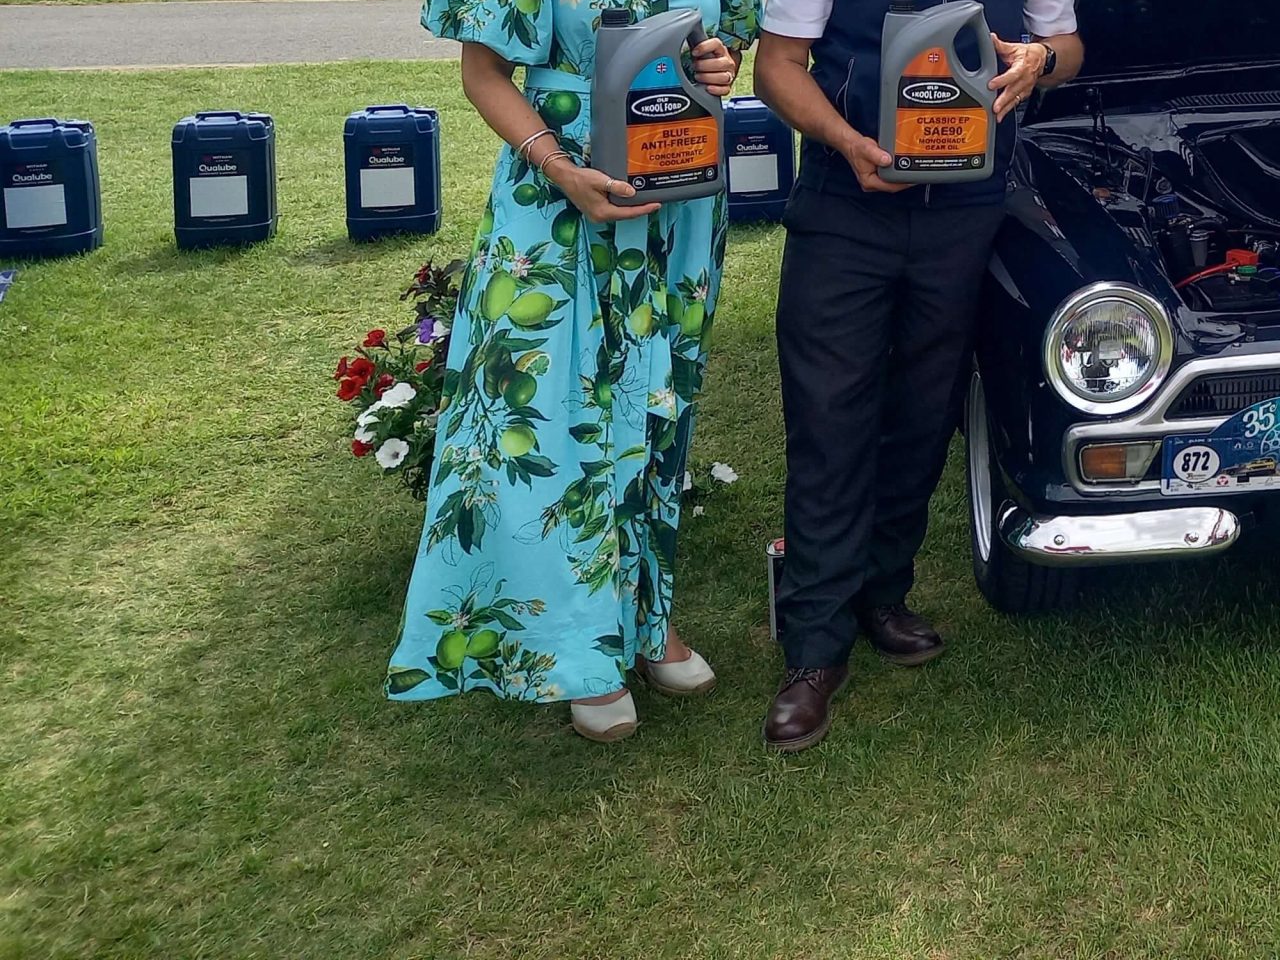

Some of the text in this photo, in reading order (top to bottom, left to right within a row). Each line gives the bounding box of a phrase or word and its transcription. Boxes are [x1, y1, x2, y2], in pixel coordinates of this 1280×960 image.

[933, 91, 951, 99] FORD
[664, 102, 682, 112] FORD
[917, 117, 957, 125] CLASSIC
[662, 127, 690, 139] BLUE
[923, 126, 963, 136] SAE90
[641, 135, 708, 151] ANTI-FREEZE
[736, 143, 769, 151] Qualube
[649, 148, 704, 161] CONCENTRATE
[368, 156, 405, 164] Qualube
[659, 156, 695, 167] COOLANT
[198, 163, 237, 172] Qualube
[12, 173, 53, 182] Qualube
[1181, 451, 1211, 473] 872
